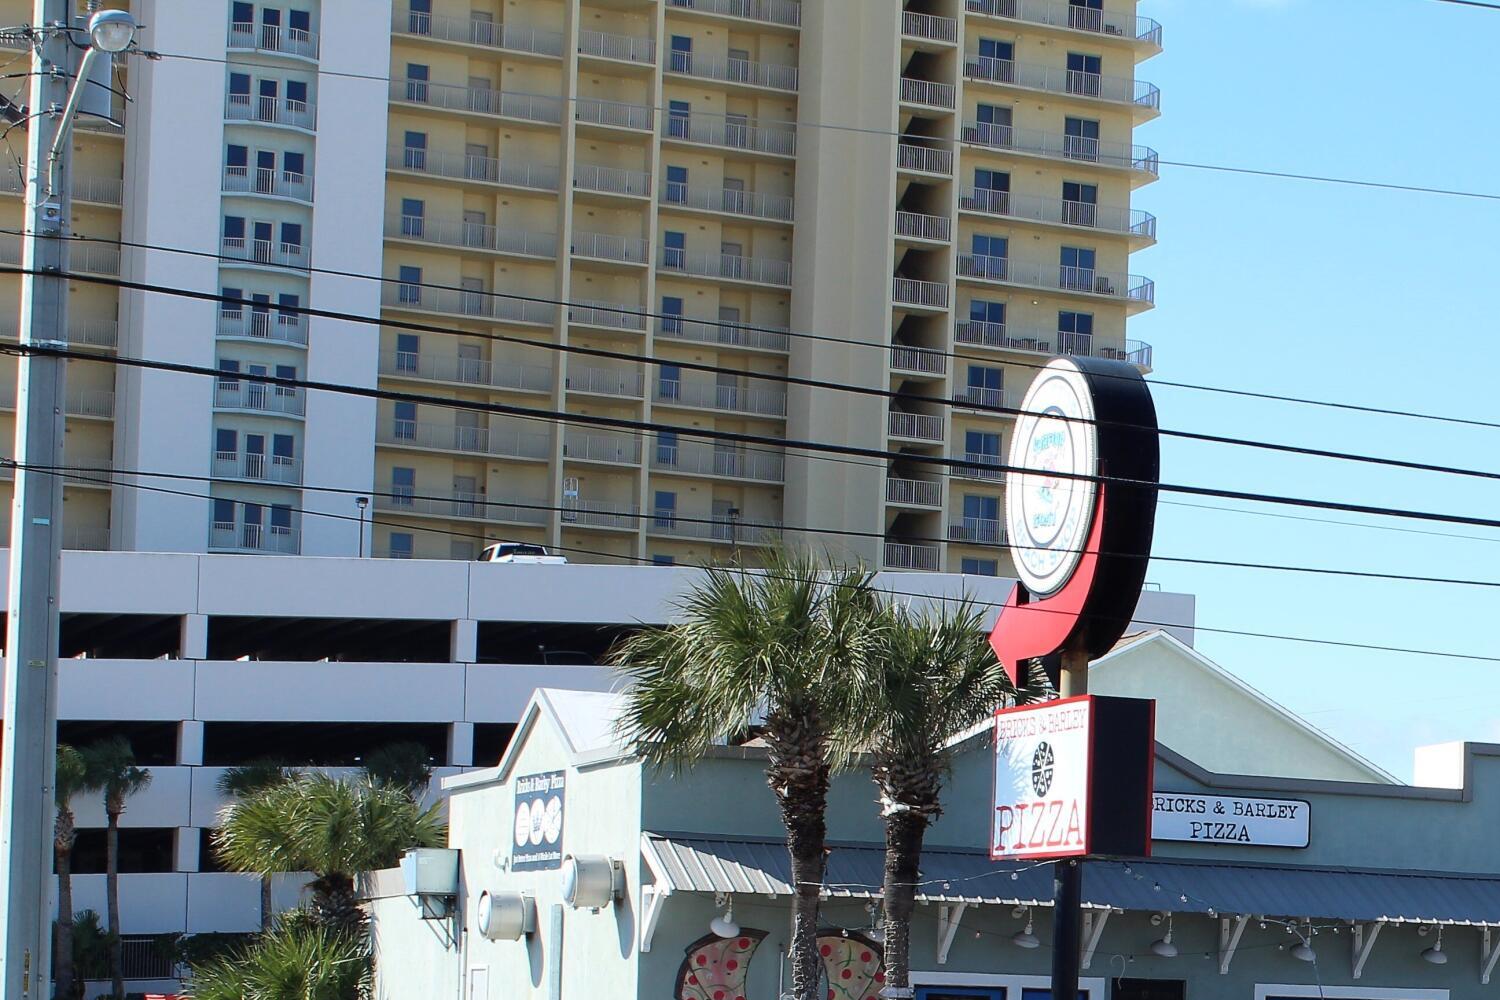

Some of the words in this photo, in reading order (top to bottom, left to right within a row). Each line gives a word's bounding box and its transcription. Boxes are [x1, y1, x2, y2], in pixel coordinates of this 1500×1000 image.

[999, 716, 1036, 741] BRICKS
[1039, 720, 1047, 736] &
[1048, 708, 1087, 735] BARLEY
[1212, 801, 1226, 815] &
[1233, 801, 1299, 819] BARLEY
[994, 799, 1084, 852] PIZZA
[1190, 821, 1251, 842] PIZZA
